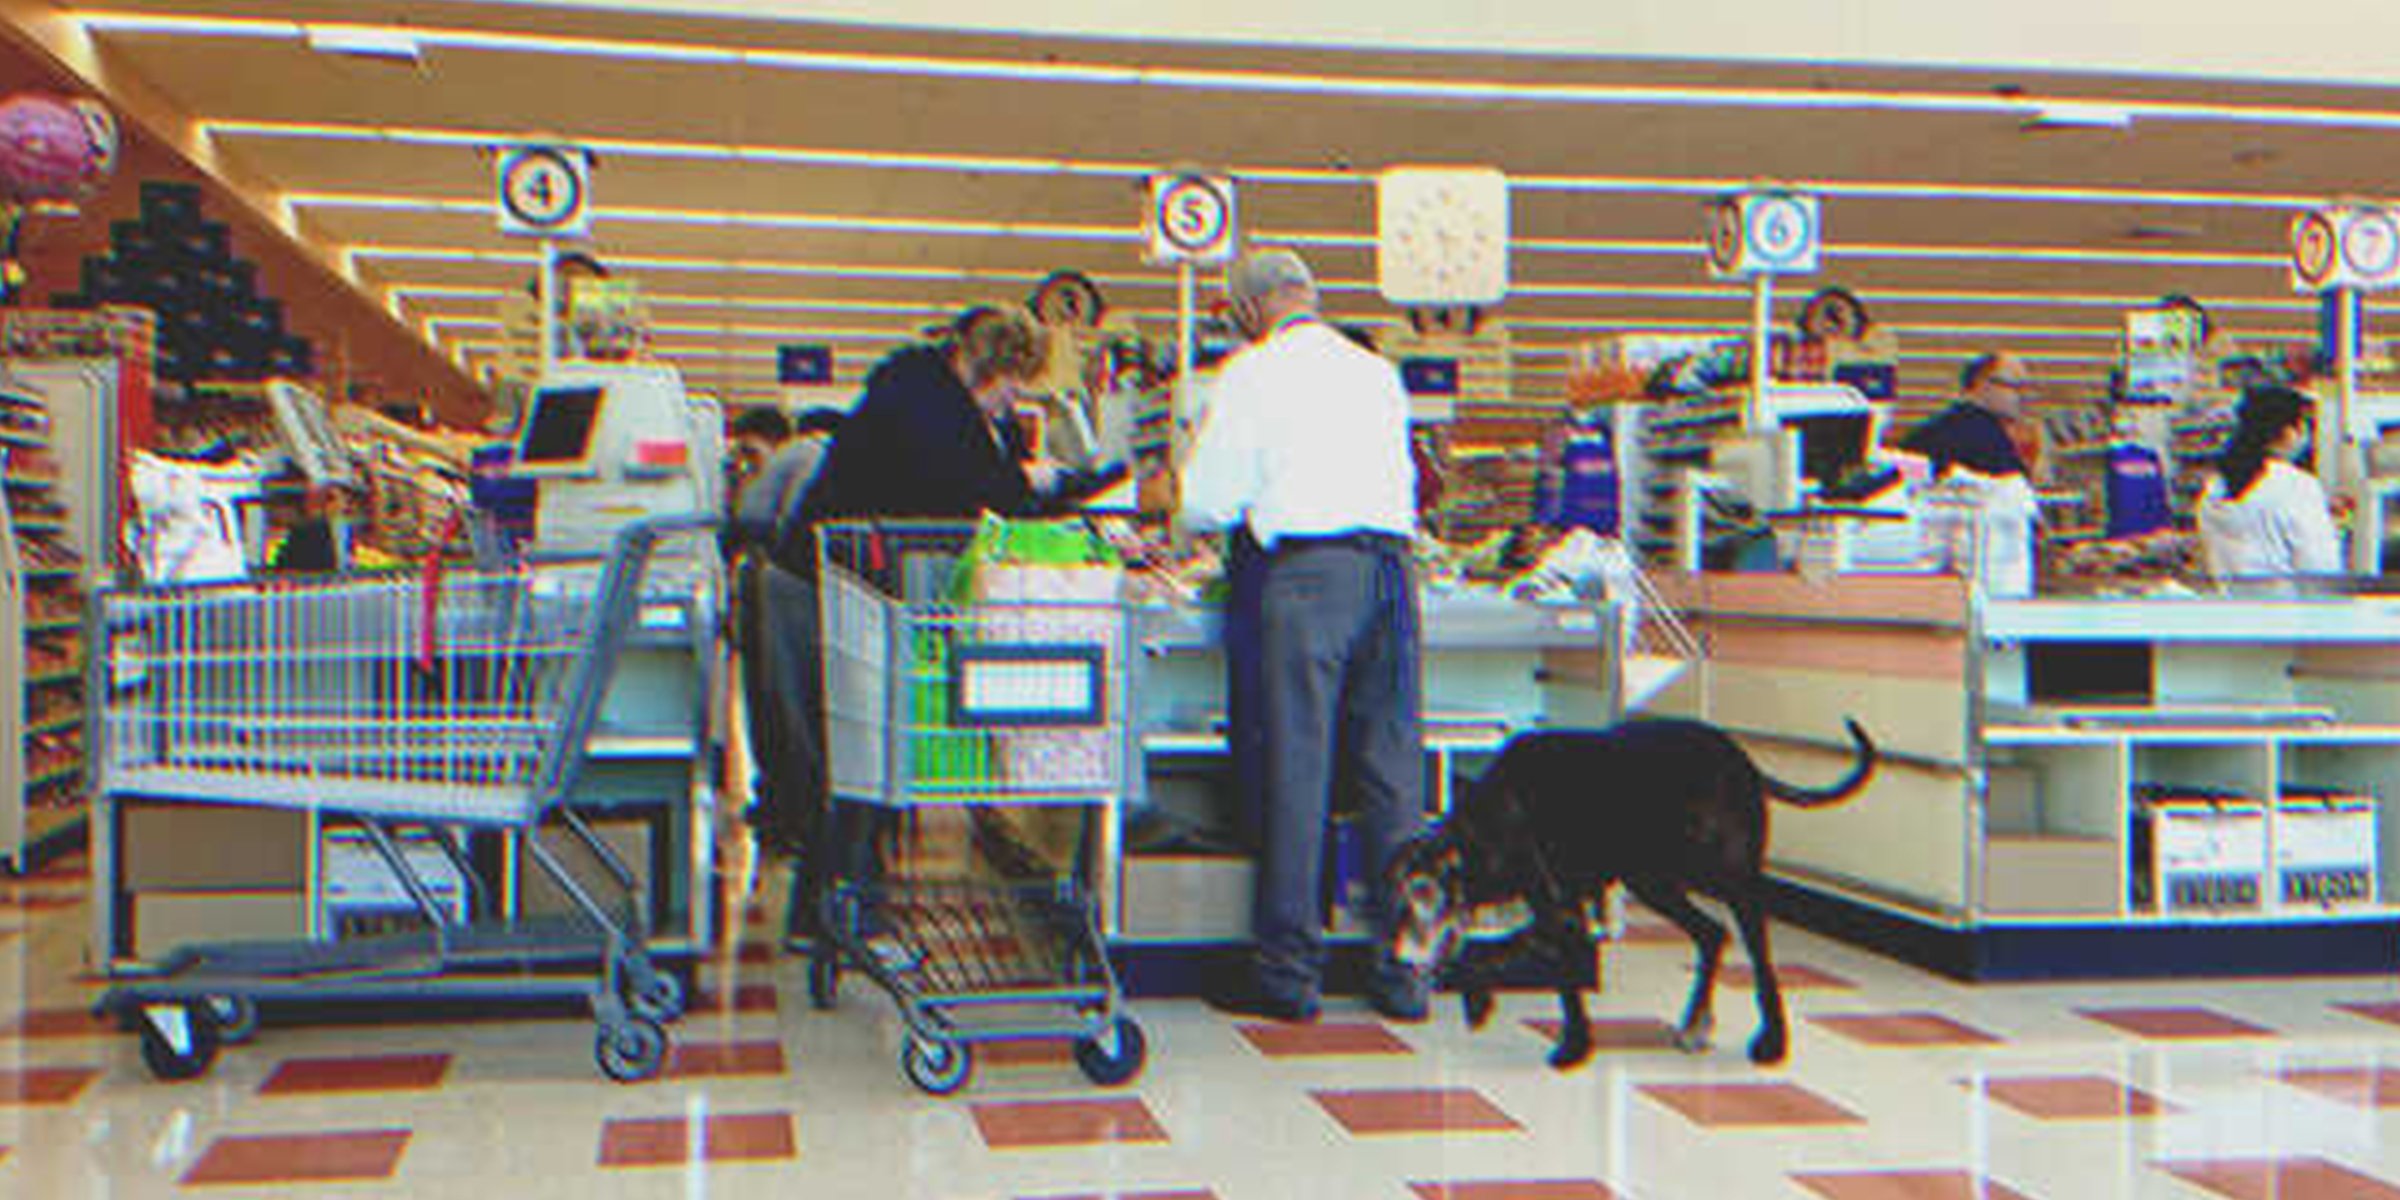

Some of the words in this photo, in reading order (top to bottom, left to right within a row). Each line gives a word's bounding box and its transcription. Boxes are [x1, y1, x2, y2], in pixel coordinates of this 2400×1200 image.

[527, 170, 552, 207] 4
[1180, 197, 1203, 234] 5
[1766, 210, 1791, 247] 6
